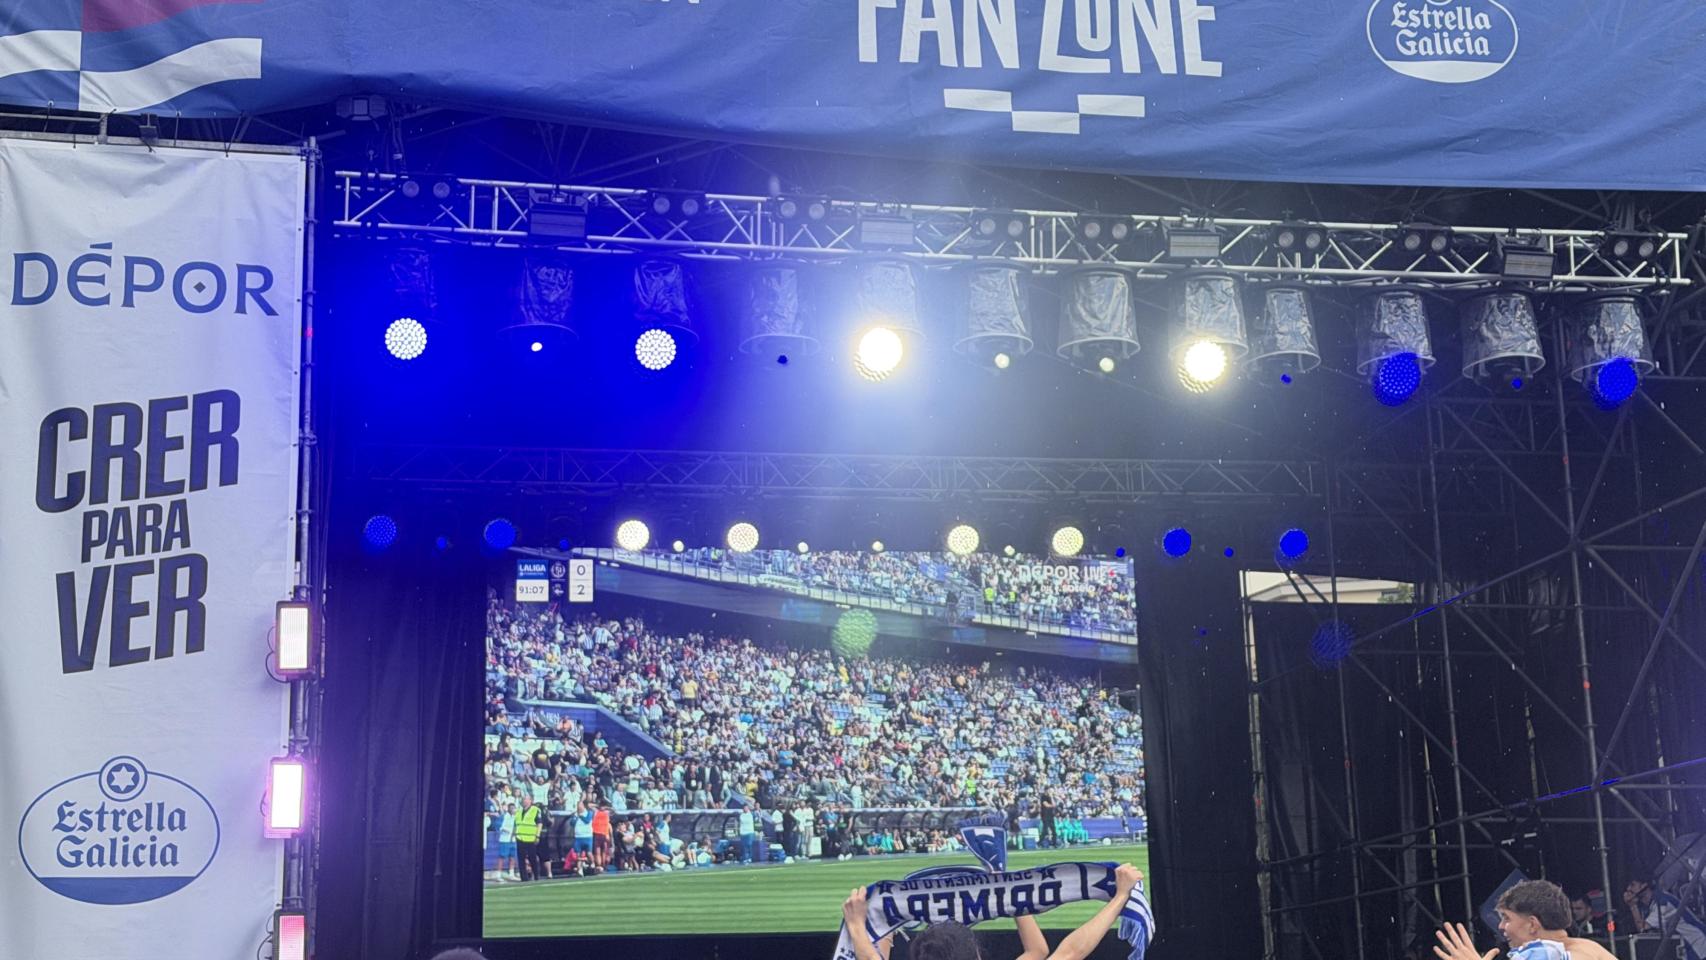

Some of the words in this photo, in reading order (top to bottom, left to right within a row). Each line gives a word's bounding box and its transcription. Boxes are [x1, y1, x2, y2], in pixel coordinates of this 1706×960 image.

[1391, 2, 1492, 31] Estrella
[1396, 29, 1490, 56] Galicia
[11, 242, 280, 316] DÉPOR
[35, 389, 241, 513] CRER
[81, 498, 191, 563] PARA
[519, 564, 546, 572] LALIGA
[576, 564, 586, 576] 0
[518, 585, 545, 594] 91:07
[576, 584, 585, 595] 2
[56, 553, 208, 674] VER
[52, 801, 187, 833] Estrella
[56, 835, 180, 868] Galicia
